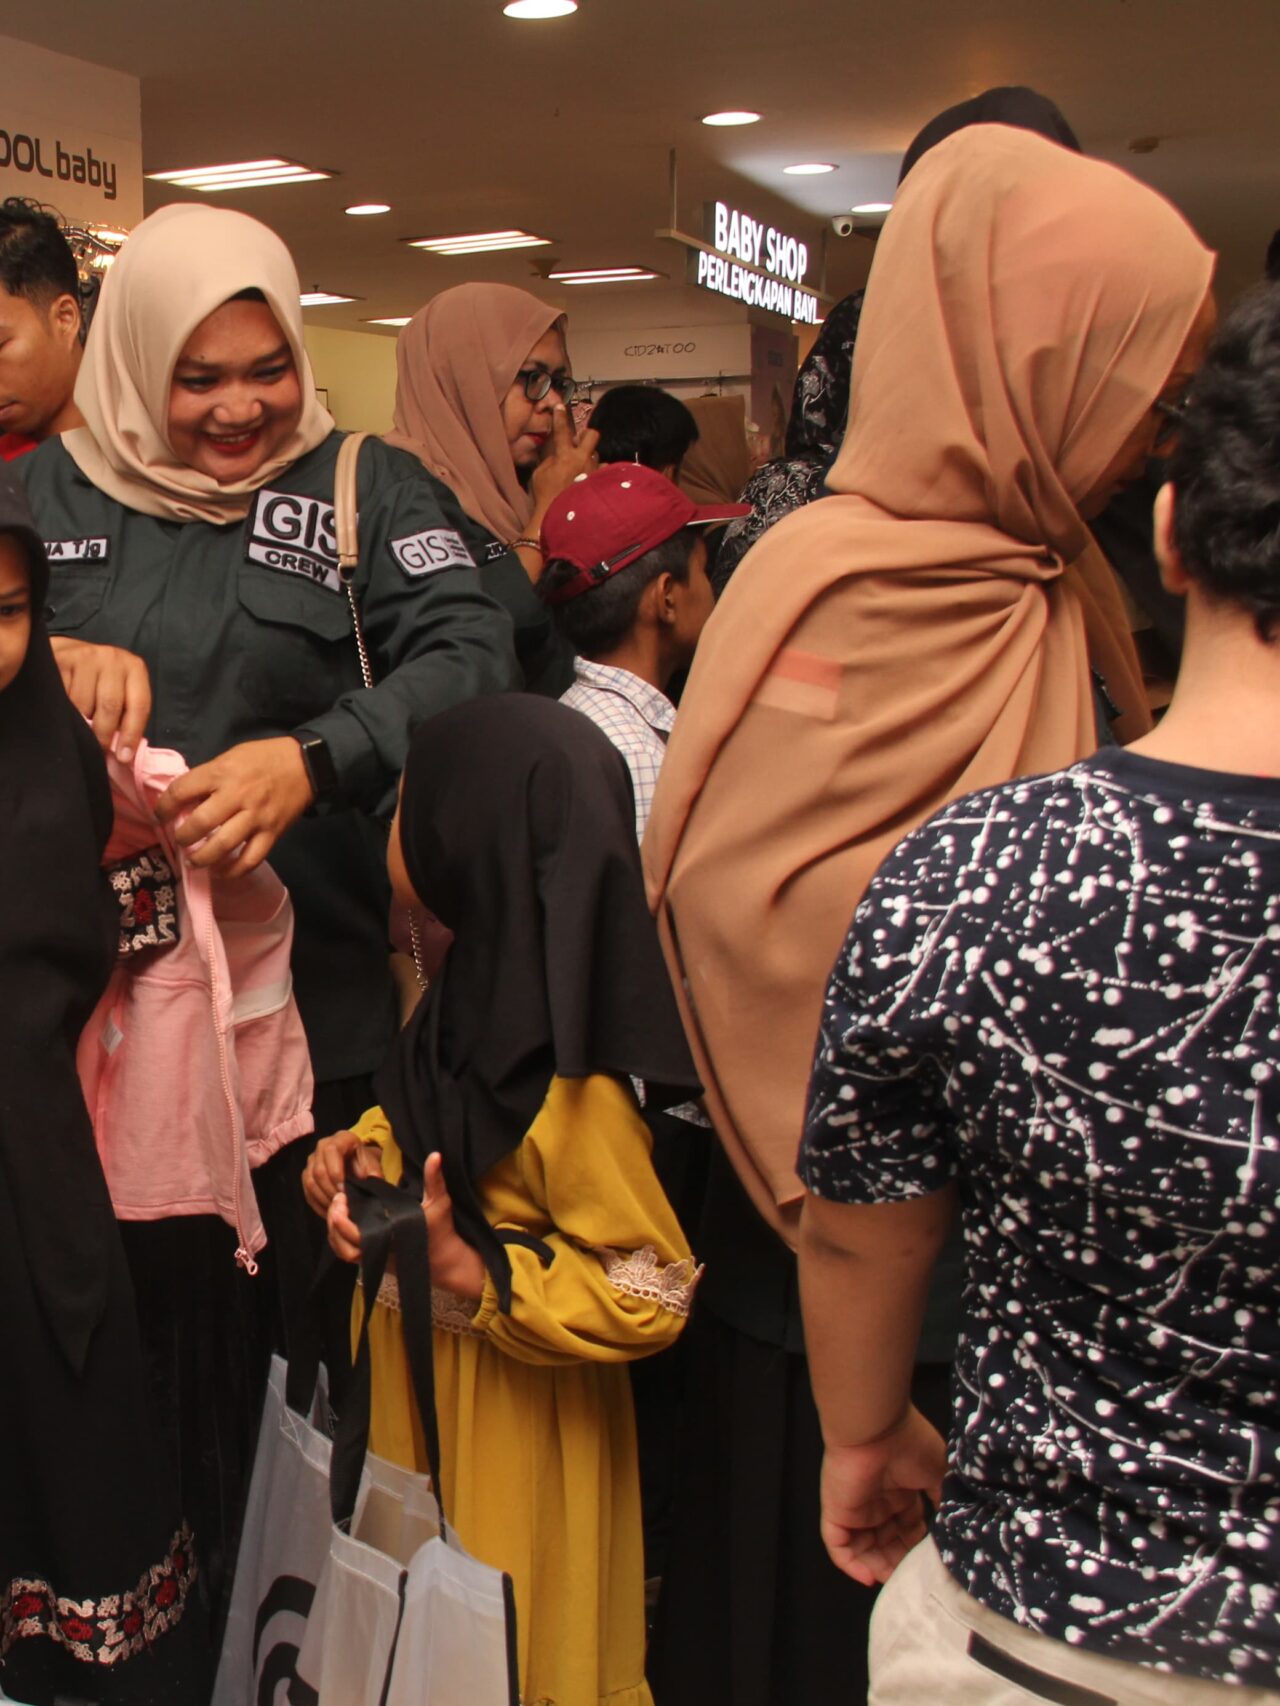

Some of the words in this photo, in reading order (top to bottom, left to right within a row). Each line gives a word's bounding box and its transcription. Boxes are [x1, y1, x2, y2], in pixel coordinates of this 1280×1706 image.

[55, 140, 117, 201] baby
[714, 201, 764, 266] BABY
[765, 226, 808, 285] SHOP
[697, 250, 792, 317] PERLENGKAPAN
[399, 535, 449, 568] GIS
